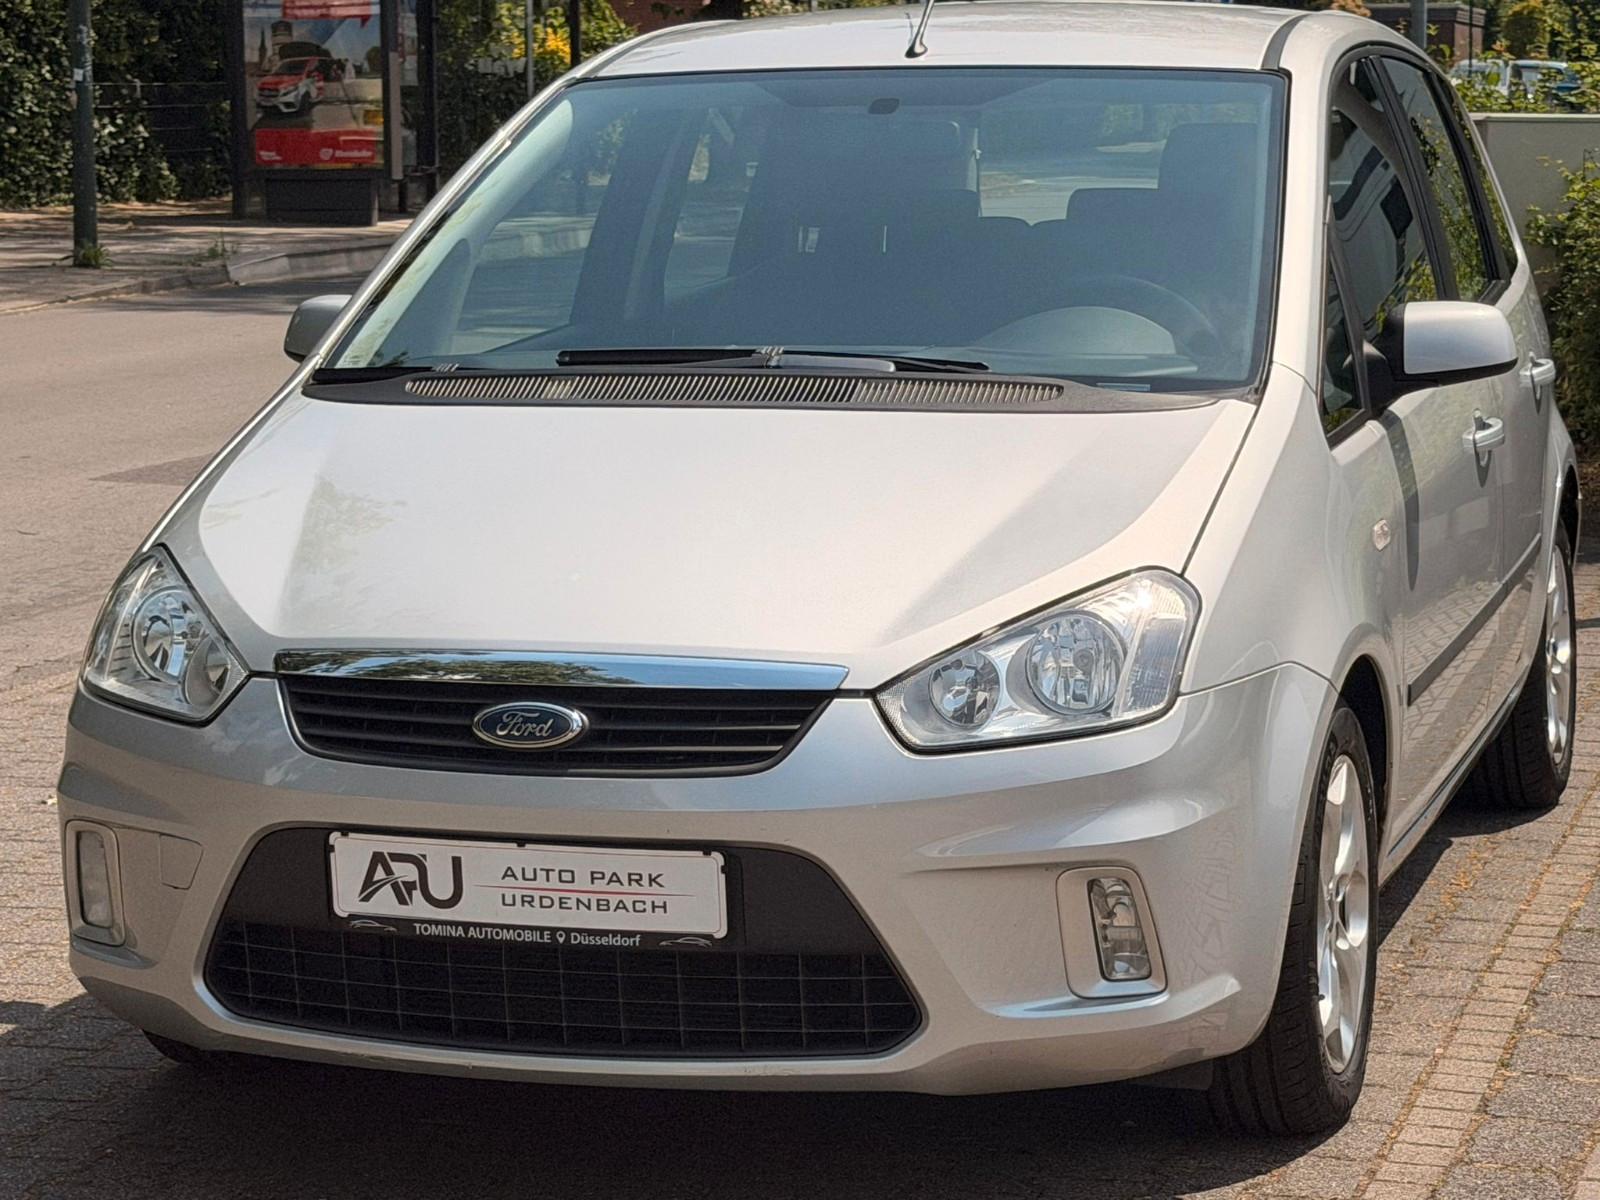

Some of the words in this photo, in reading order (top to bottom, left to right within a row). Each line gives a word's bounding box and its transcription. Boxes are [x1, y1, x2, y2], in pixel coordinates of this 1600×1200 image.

[496, 711, 554, 737] Ford
[501, 866, 576, 884] AUTO
[590, 870, 665, 888] PARK
[501, 893, 668, 914] URDENBACH
[413, 923, 466, 938] TOMINA
[467, 927, 552, 943] AUTOMOBILE
[570, 932, 641, 947] Düsseldorf
